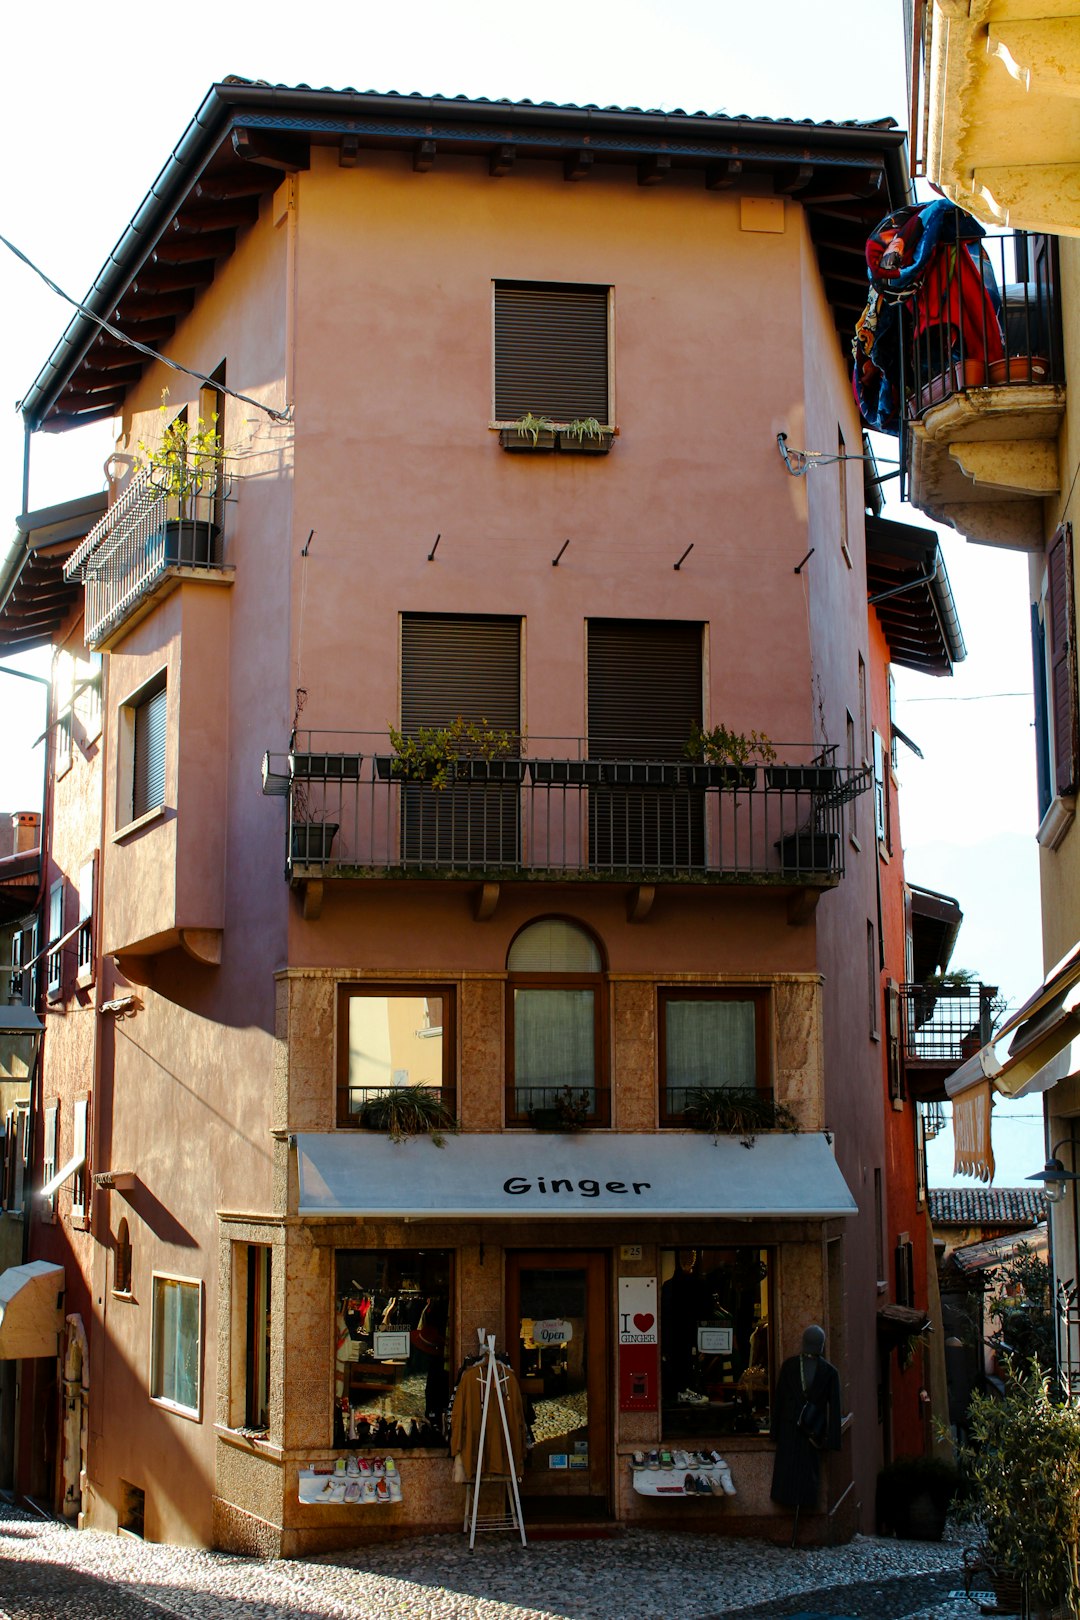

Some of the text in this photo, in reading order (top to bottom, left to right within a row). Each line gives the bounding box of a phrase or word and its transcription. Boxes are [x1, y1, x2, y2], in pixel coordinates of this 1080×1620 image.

[503, 1177, 651, 1197] Ginger
[630, 1247, 641, 1256] 25
[621, 1314, 630, 1333] I
[541, 1329, 564, 1343] Open
[621, 1334, 656, 1343] GINGER
